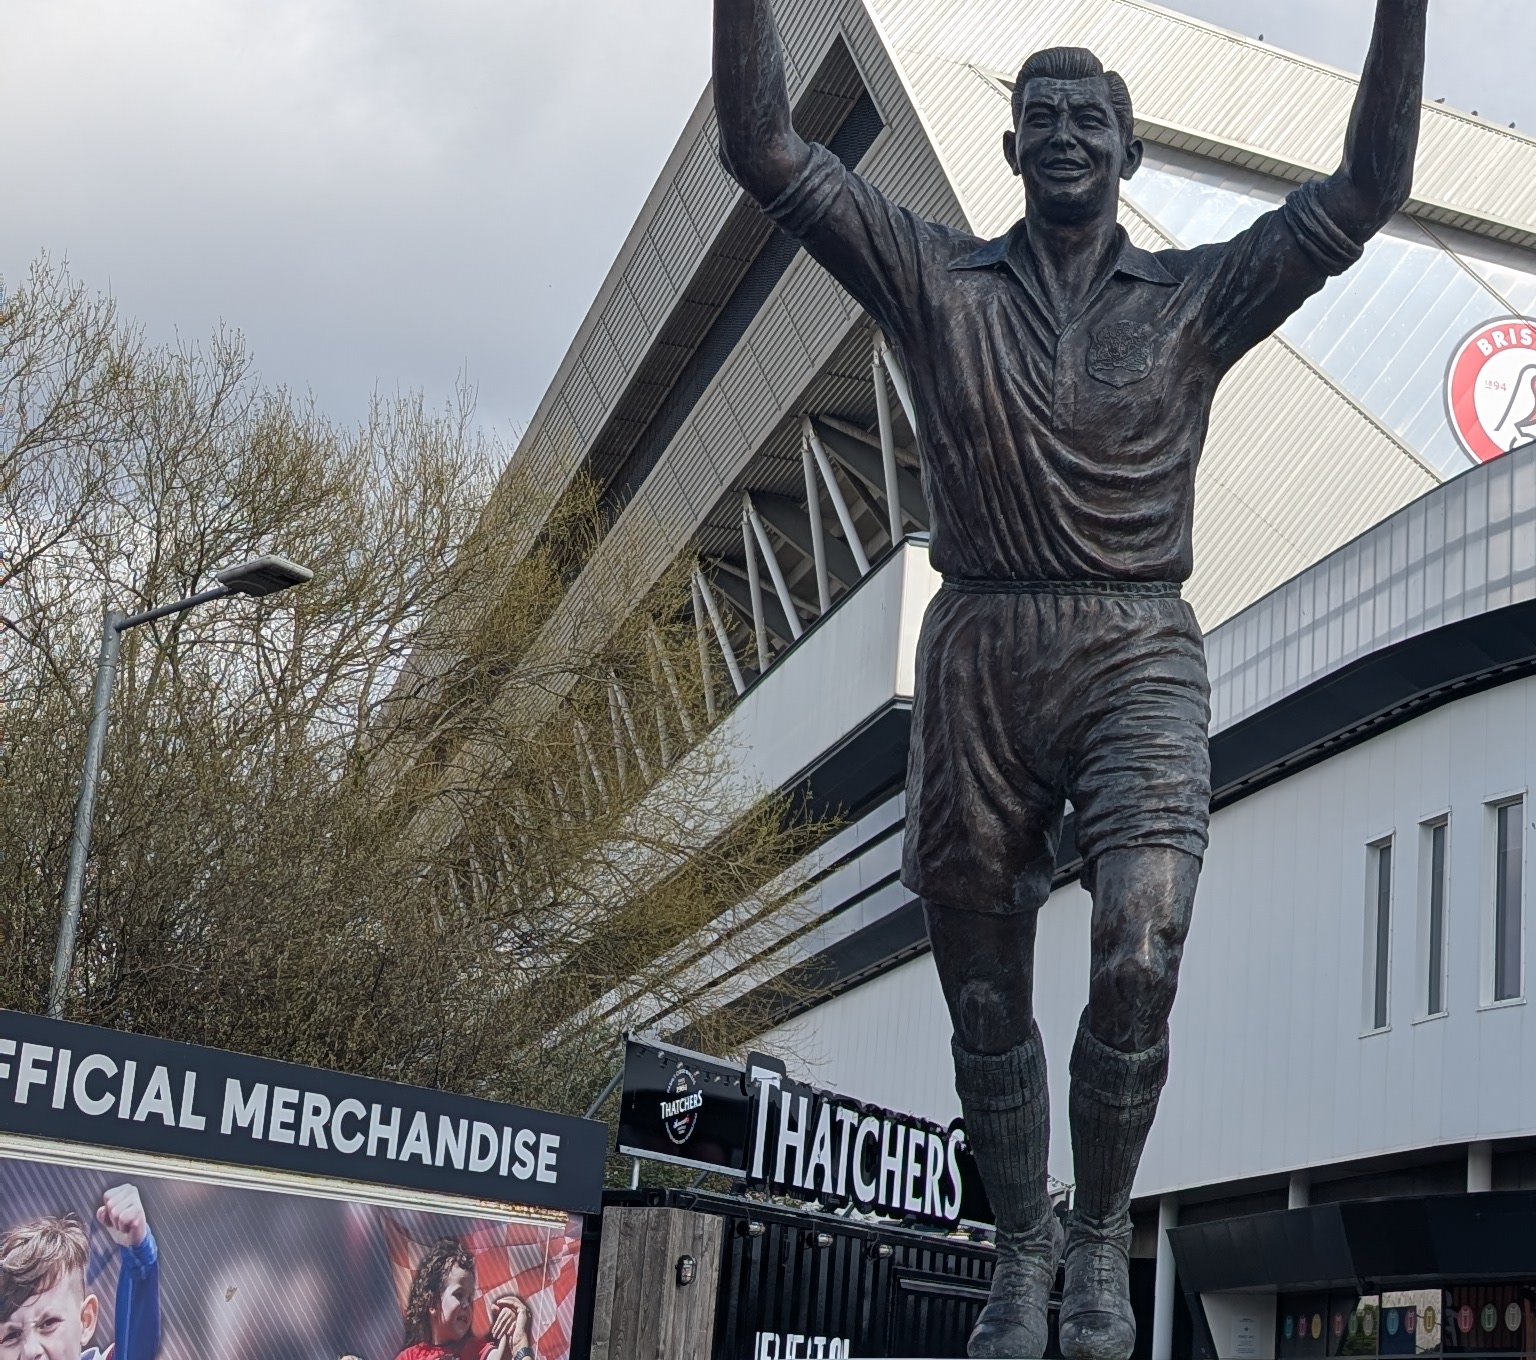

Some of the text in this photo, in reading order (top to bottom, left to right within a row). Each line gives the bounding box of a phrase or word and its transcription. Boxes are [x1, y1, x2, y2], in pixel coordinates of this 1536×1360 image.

[1485, 380, 1507, 392] 1894
[220, 1077, 560, 1183] MERCHANDISE
[660, 1089, 703, 1120] THATCHERS
[750, 1065, 965, 1220] THATCHERS
